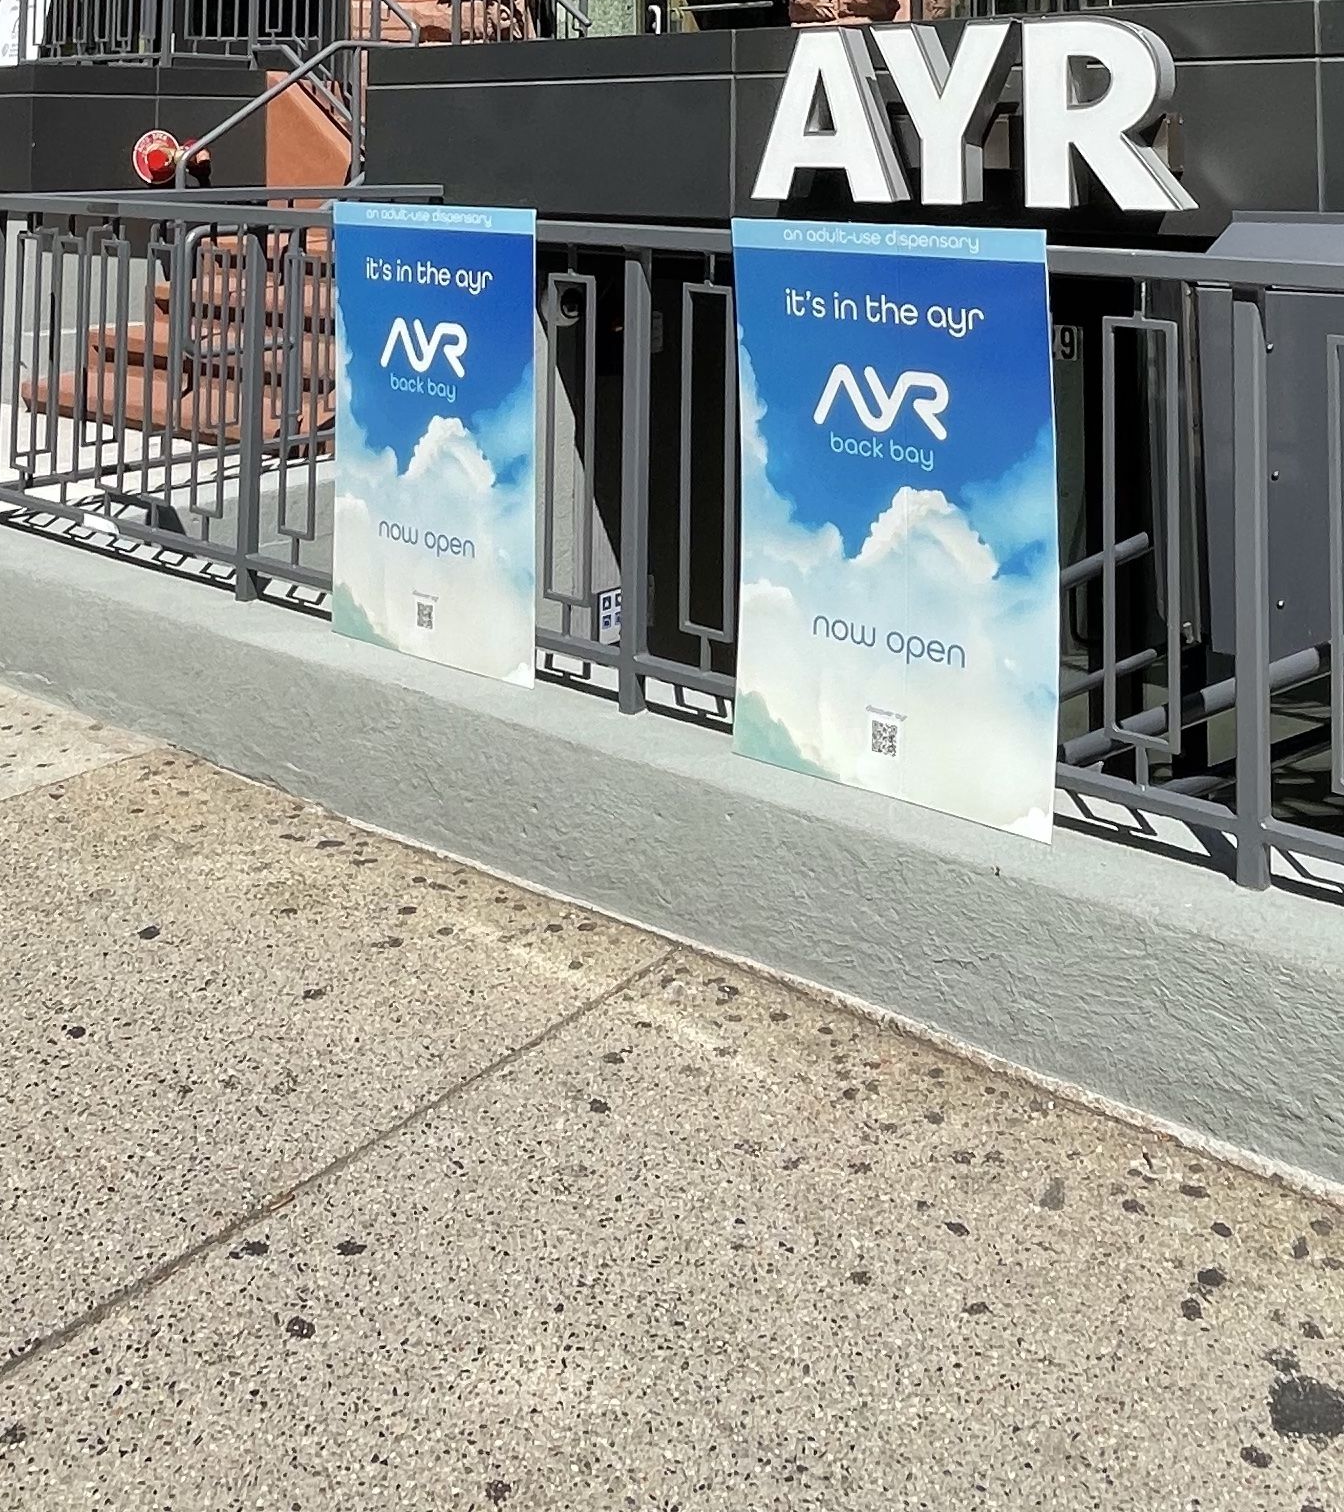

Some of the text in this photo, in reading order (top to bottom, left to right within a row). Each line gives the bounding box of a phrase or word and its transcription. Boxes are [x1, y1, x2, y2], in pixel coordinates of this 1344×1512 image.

[750, 15, 1199, 211] AYR
[432, 209, 493, 228] dispensary
[783, 227, 980, 253] an adult-use dispensary
[365, 256, 494, 296] it's in the ayr
[784, 288, 985, 338] it's in the ayr
[380, 316, 468, 378] AYR
[389, 372, 457, 403] back bay
[813, 362, 950, 441] AYR
[830, 431, 935, 472] back bay
[378, 520, 476, 558] now open
[813, 615, 966, 669] now open
